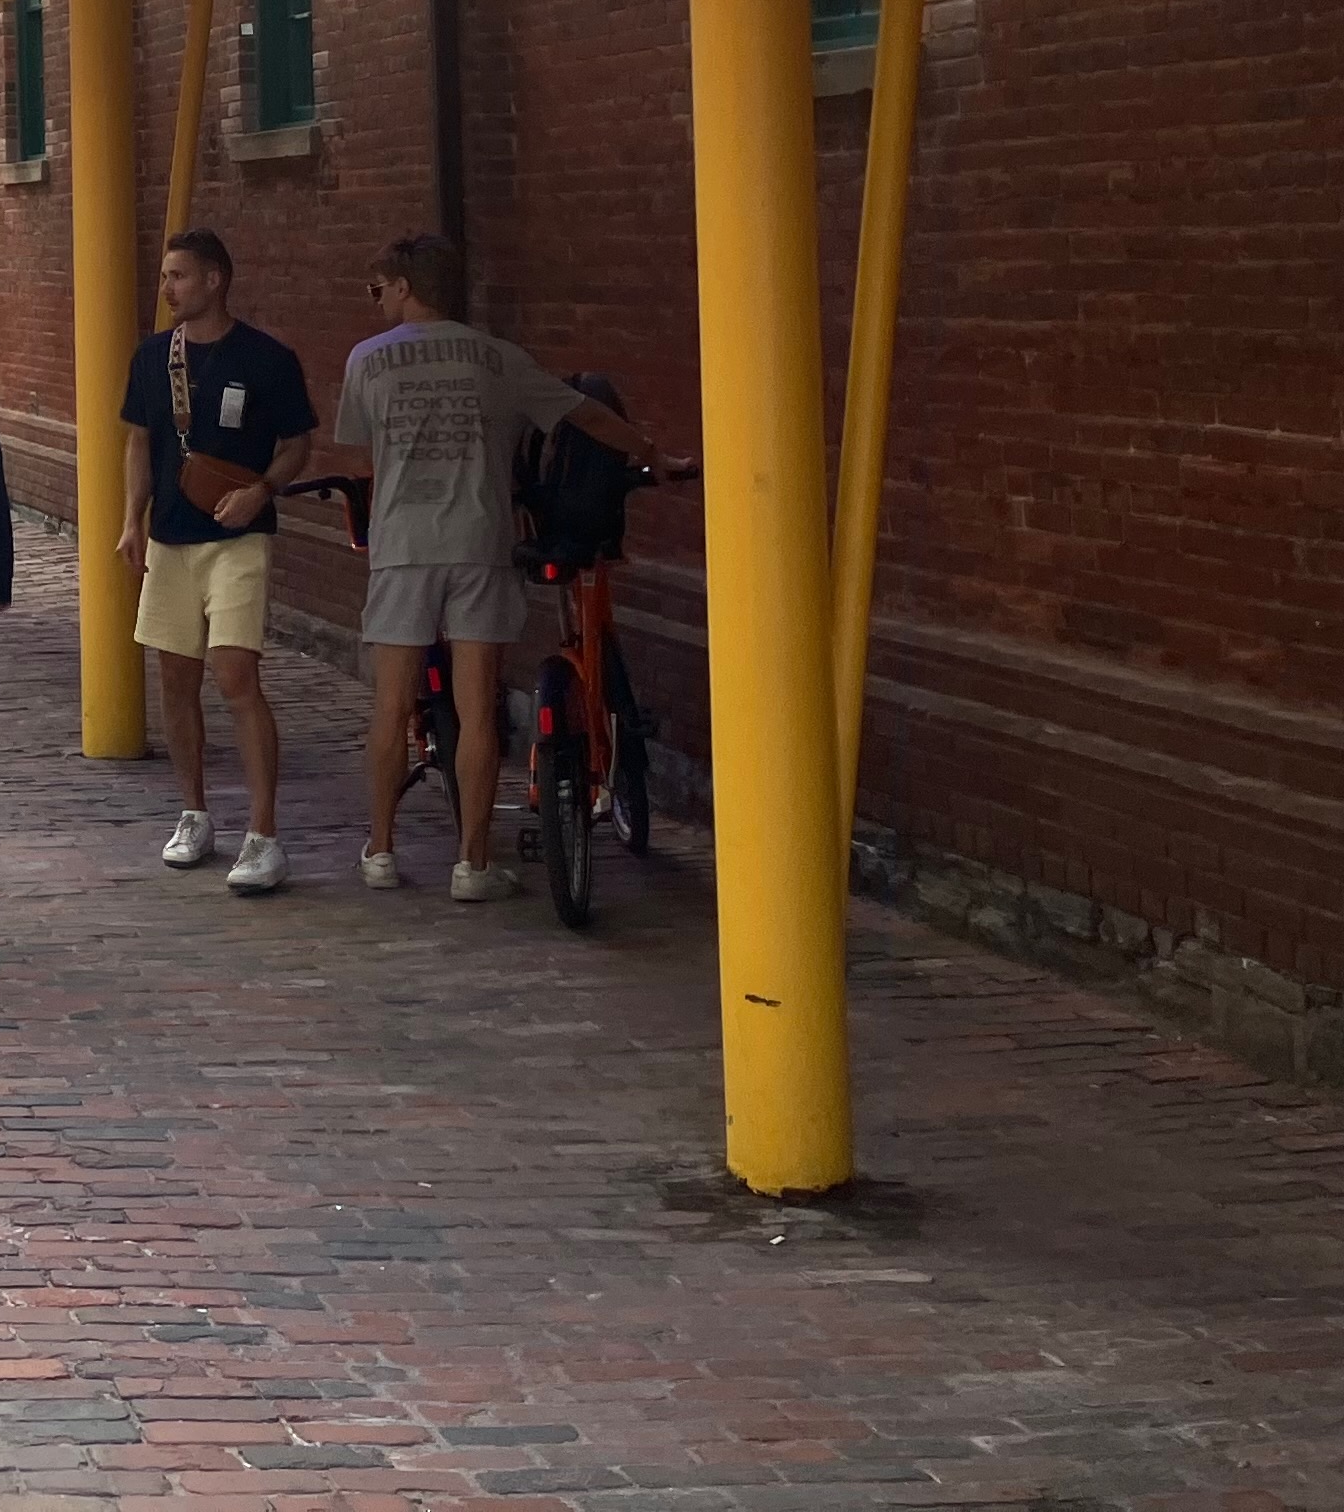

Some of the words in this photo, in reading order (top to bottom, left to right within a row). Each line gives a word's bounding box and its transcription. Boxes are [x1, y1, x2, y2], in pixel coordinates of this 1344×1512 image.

[398, 378, 475, 394] PARIS
[392, 396, 481, 412] TOKYO
[386, 430, 485, 445] LONDON
